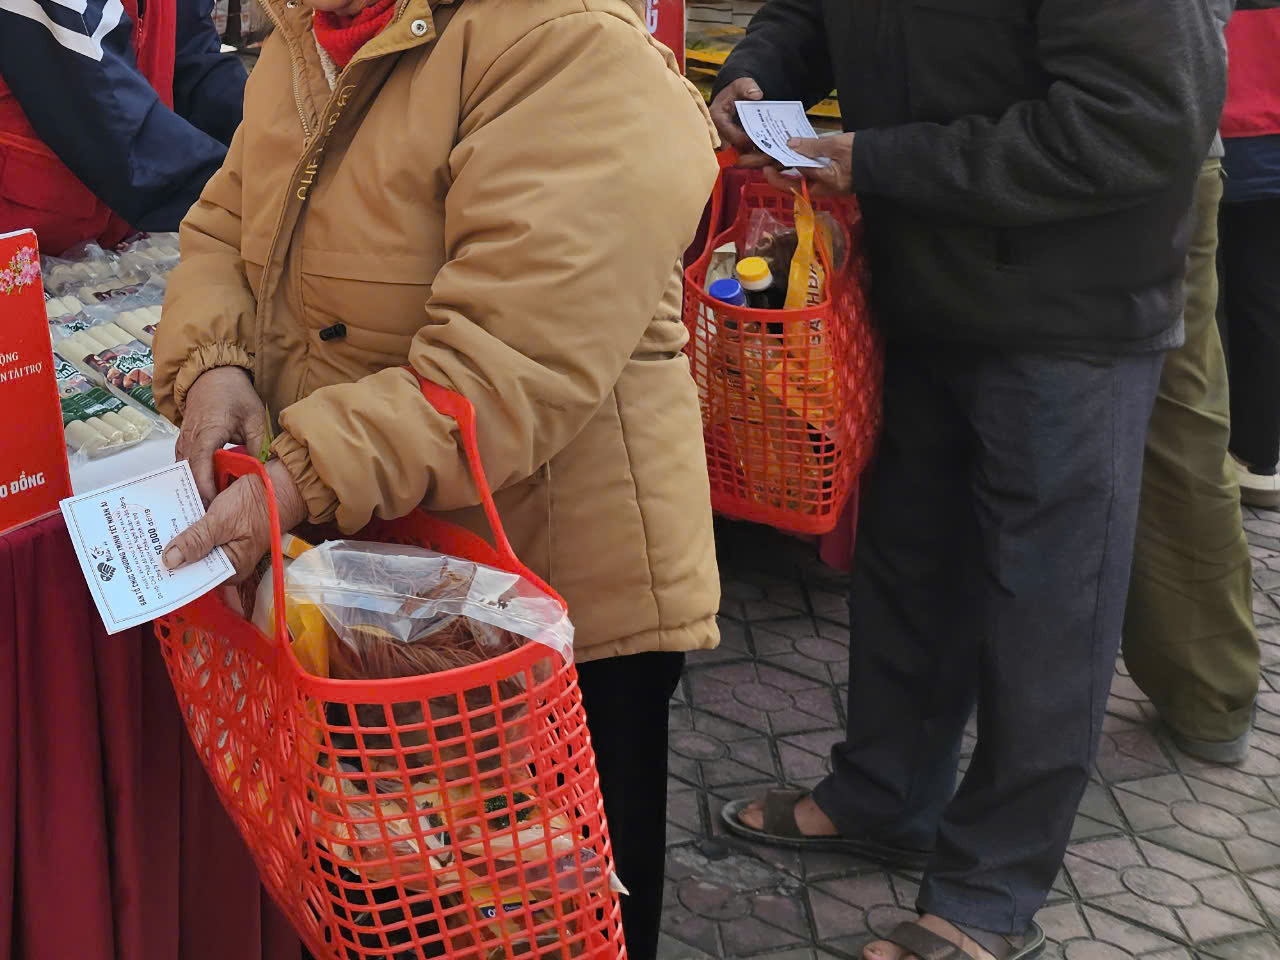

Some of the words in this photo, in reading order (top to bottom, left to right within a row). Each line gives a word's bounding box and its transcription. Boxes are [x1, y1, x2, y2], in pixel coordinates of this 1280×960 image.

[8, 367, 23, 381] TÀI
[24, 362, 43, 375] TRỢ
[10, 471, 45, 494] ĐỒNG
[103, 508, 114, 524] NHÂN
[143, 508, 155, 527] đồng
[108, 524, 117, 535] TẾT
[113, 534, 124, 551] TRÌNH
[148, 527, 165, 555] 50.000
[119, 551, 132, 573] CHƯƠNG
[128, 573, 138, 588] CHỨC
[132, 587, 141, 595] TỔ
[137, 594, 146, 606] BAN
